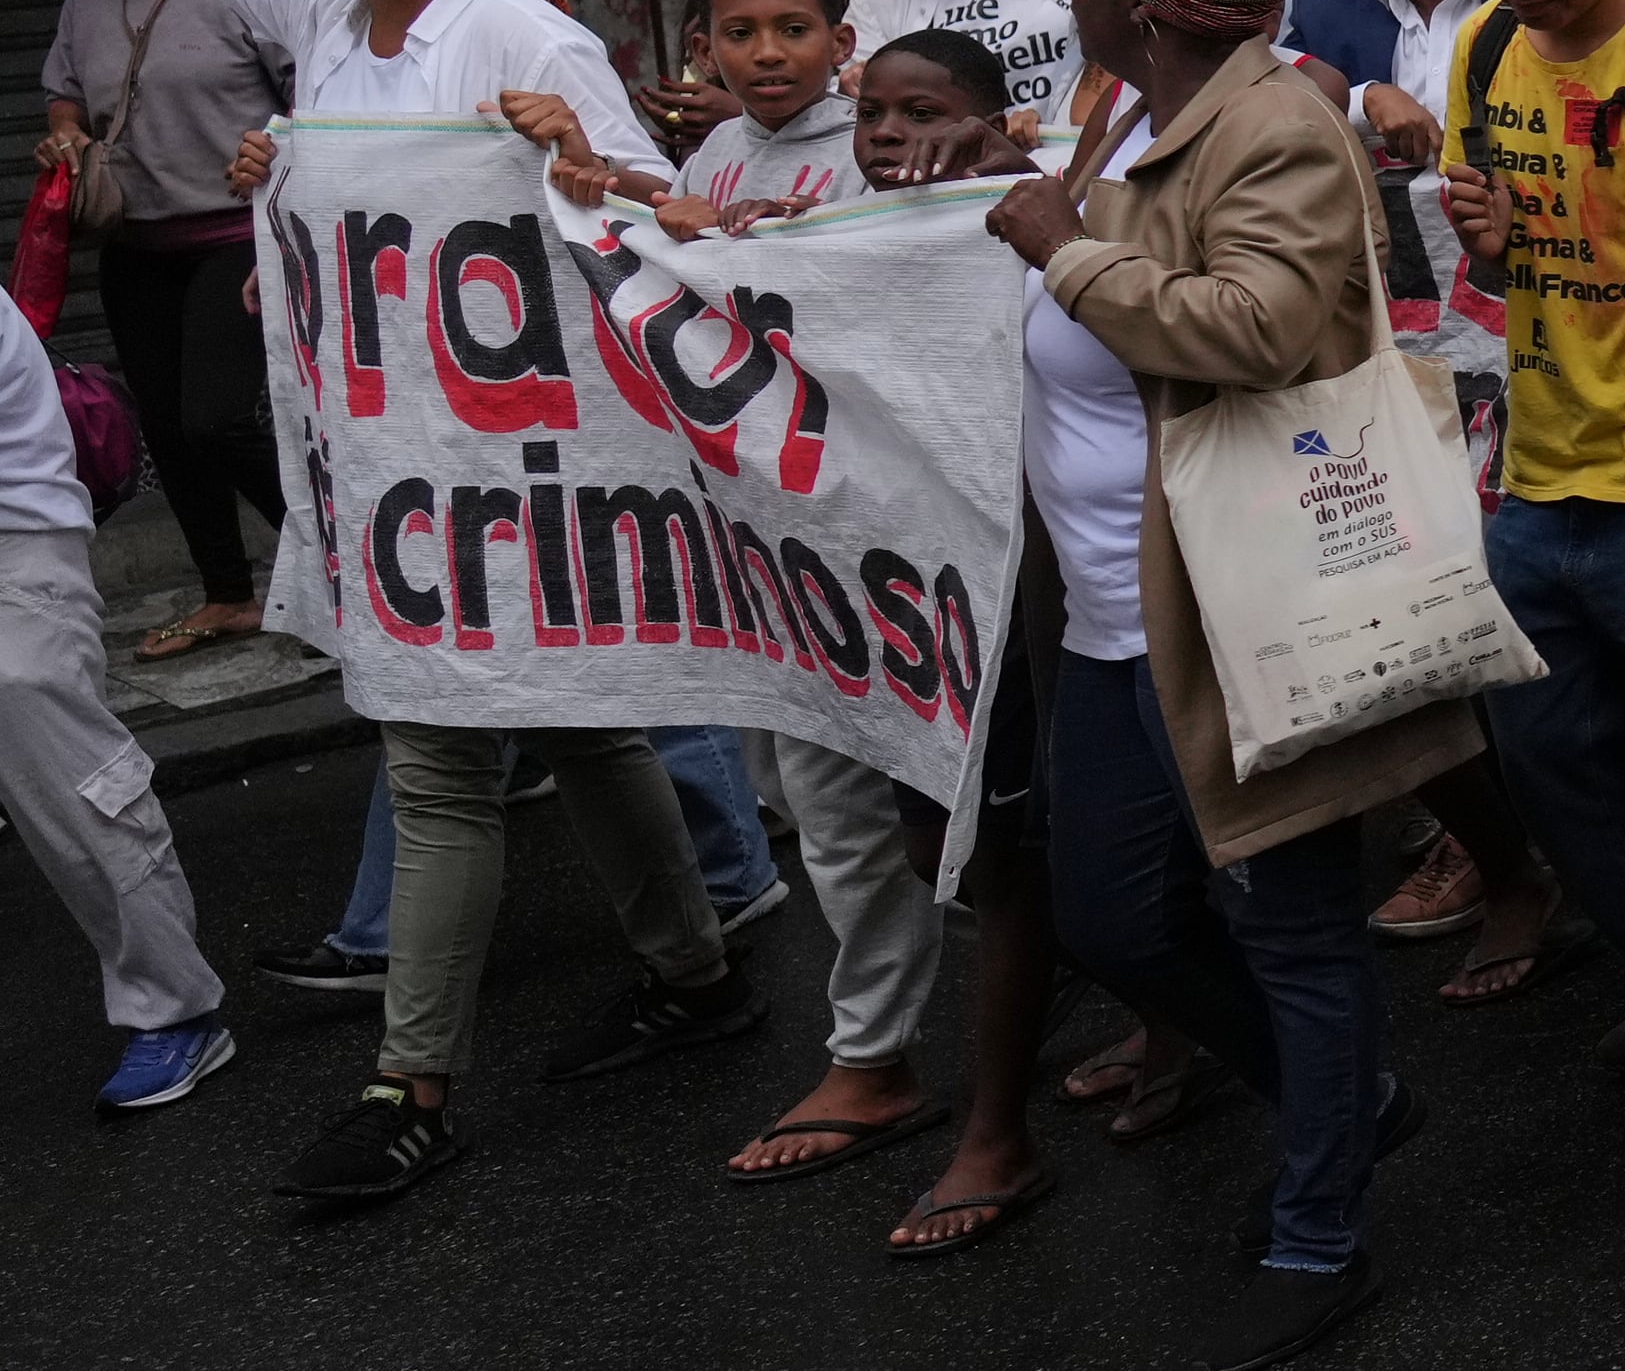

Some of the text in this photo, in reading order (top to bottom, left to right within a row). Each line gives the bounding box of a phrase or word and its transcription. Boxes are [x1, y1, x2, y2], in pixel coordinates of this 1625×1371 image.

[1528, 107, 1547, 135] &
[1552, 153, 1566, 181] &
[1552, 193, 1568, 217] &
[1579, 237, 1596, 264] &
[1309, 466, 1320, 483] O
[1299, 472, 1389, 509] cuidando
[1315, 503, 1338, 525] do
[1318, 511, 1393, 543] em diálogo
[1322, 522, 1397, 558] com o SUS
[1318, 541, 1412, 578] PESQUISA EM AÇÃO
[362, 439, 980, 743] criminoso
